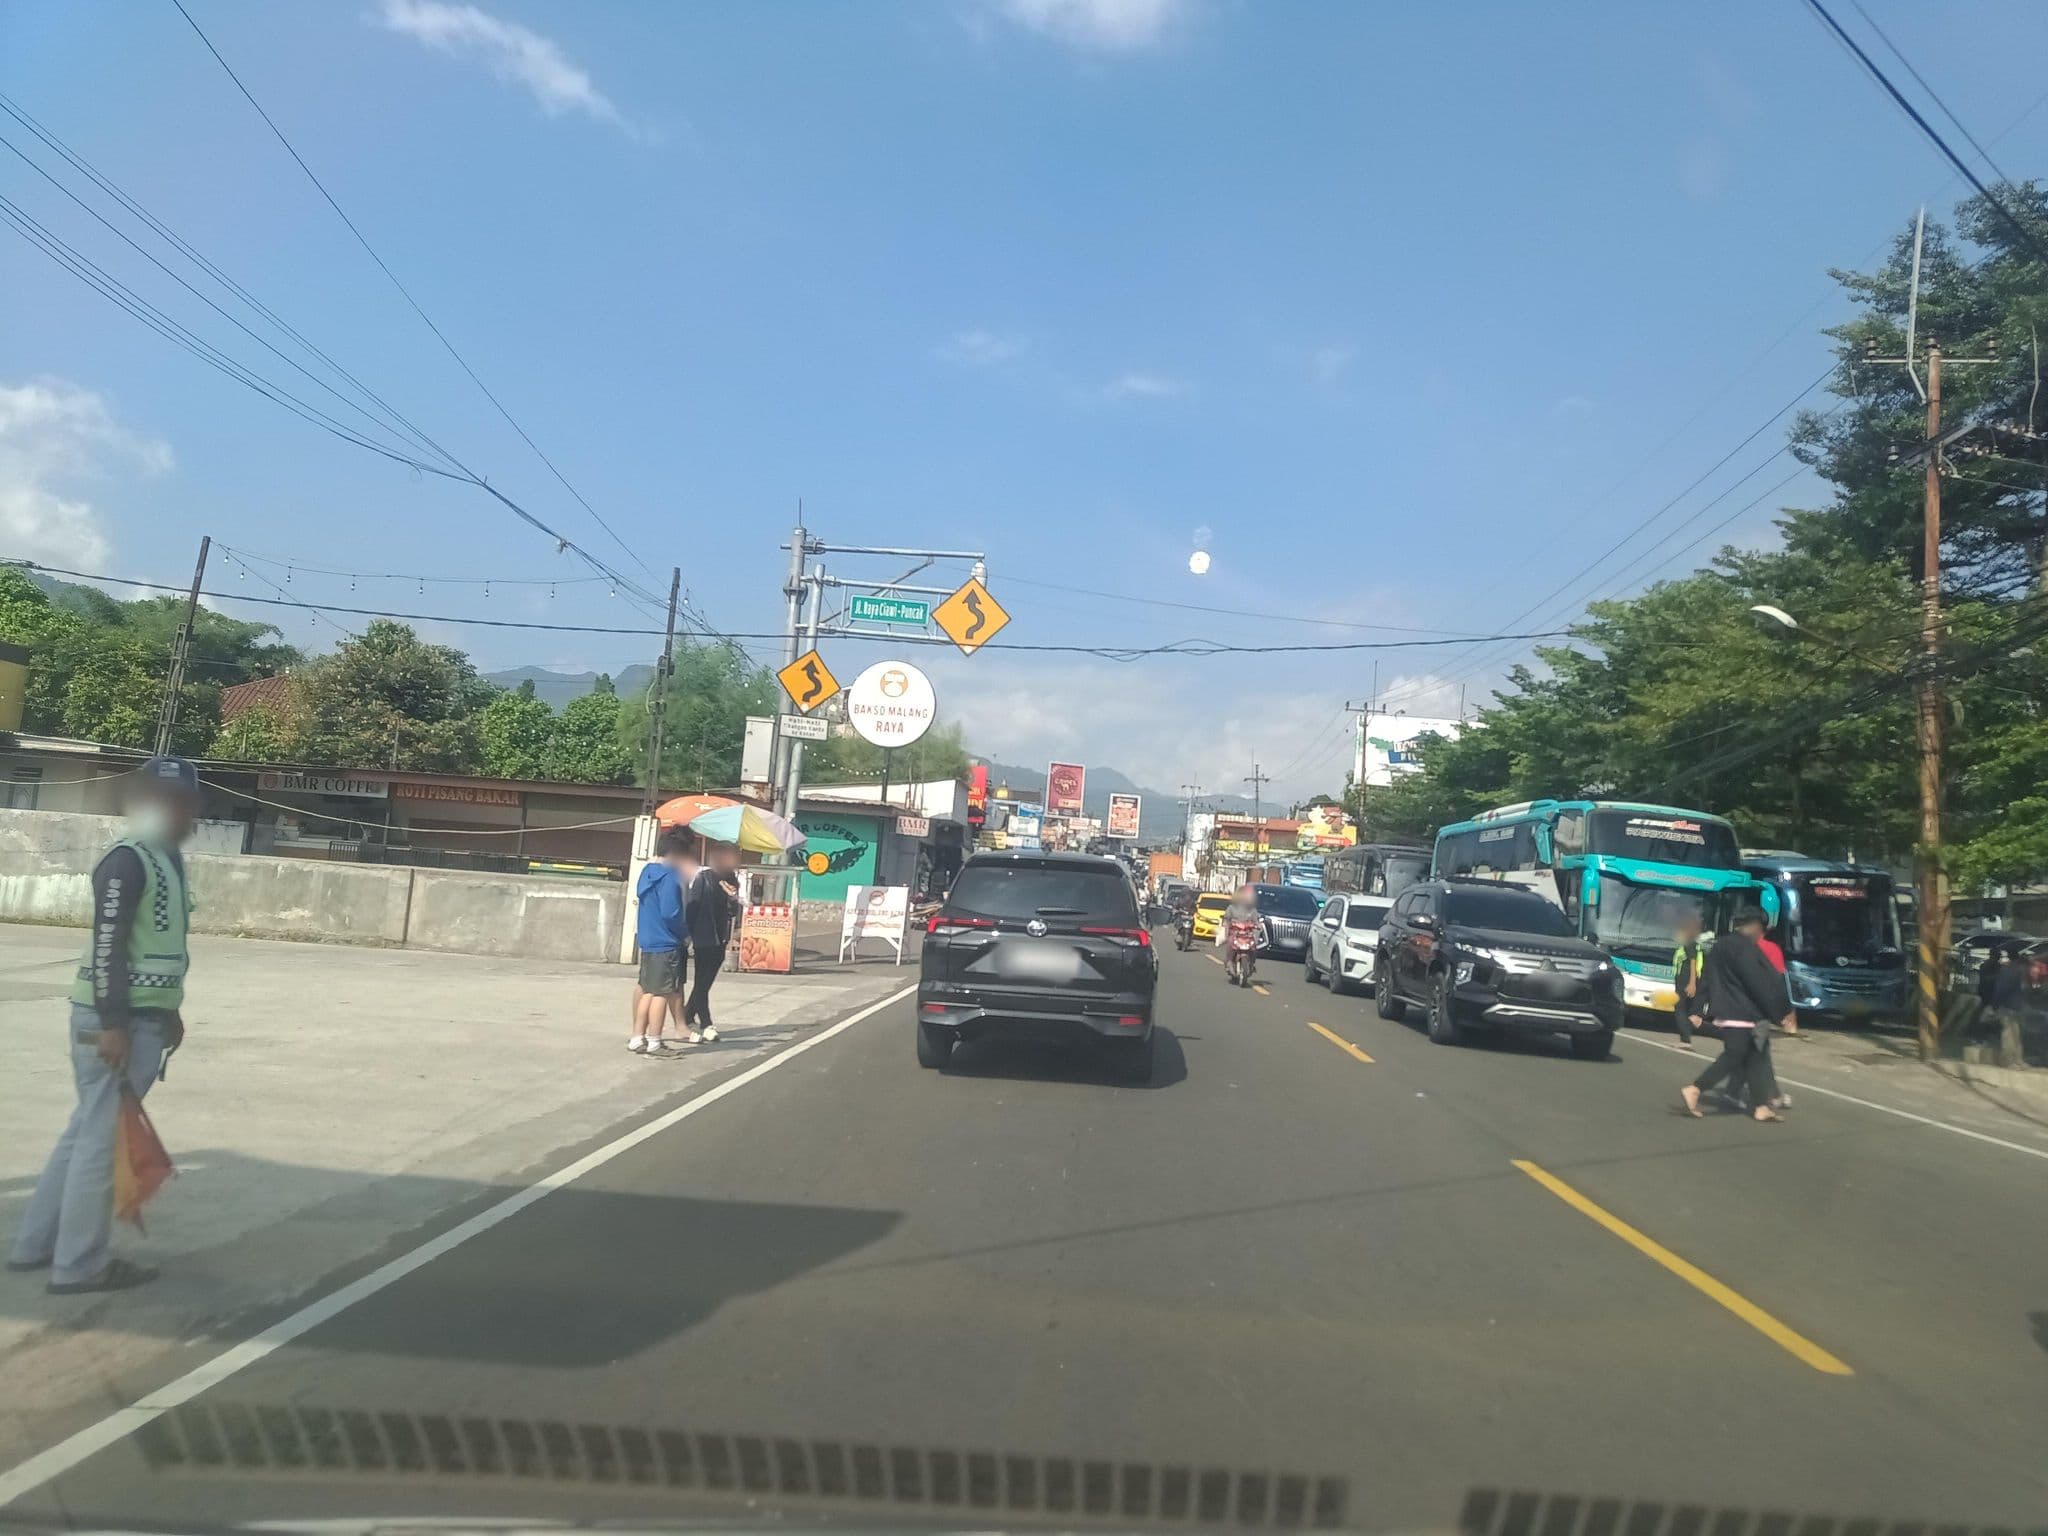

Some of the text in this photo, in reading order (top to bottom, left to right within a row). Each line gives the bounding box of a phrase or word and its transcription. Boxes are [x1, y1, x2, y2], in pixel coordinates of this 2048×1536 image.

[863, 601, 879, 619] Raya
[879, 602, 897, 618] Ciawi
[900, 604, 924, 620] Puncak
[853, 703, 928, 719] BAKSO MALANG
[875, 720, 904, 734] RAYA
[284, 775, 319, 790] BMR
[396, 783, 519, 805] ROTI PISANG BAKAR
[813, 823, 860, 846] COFFEE
